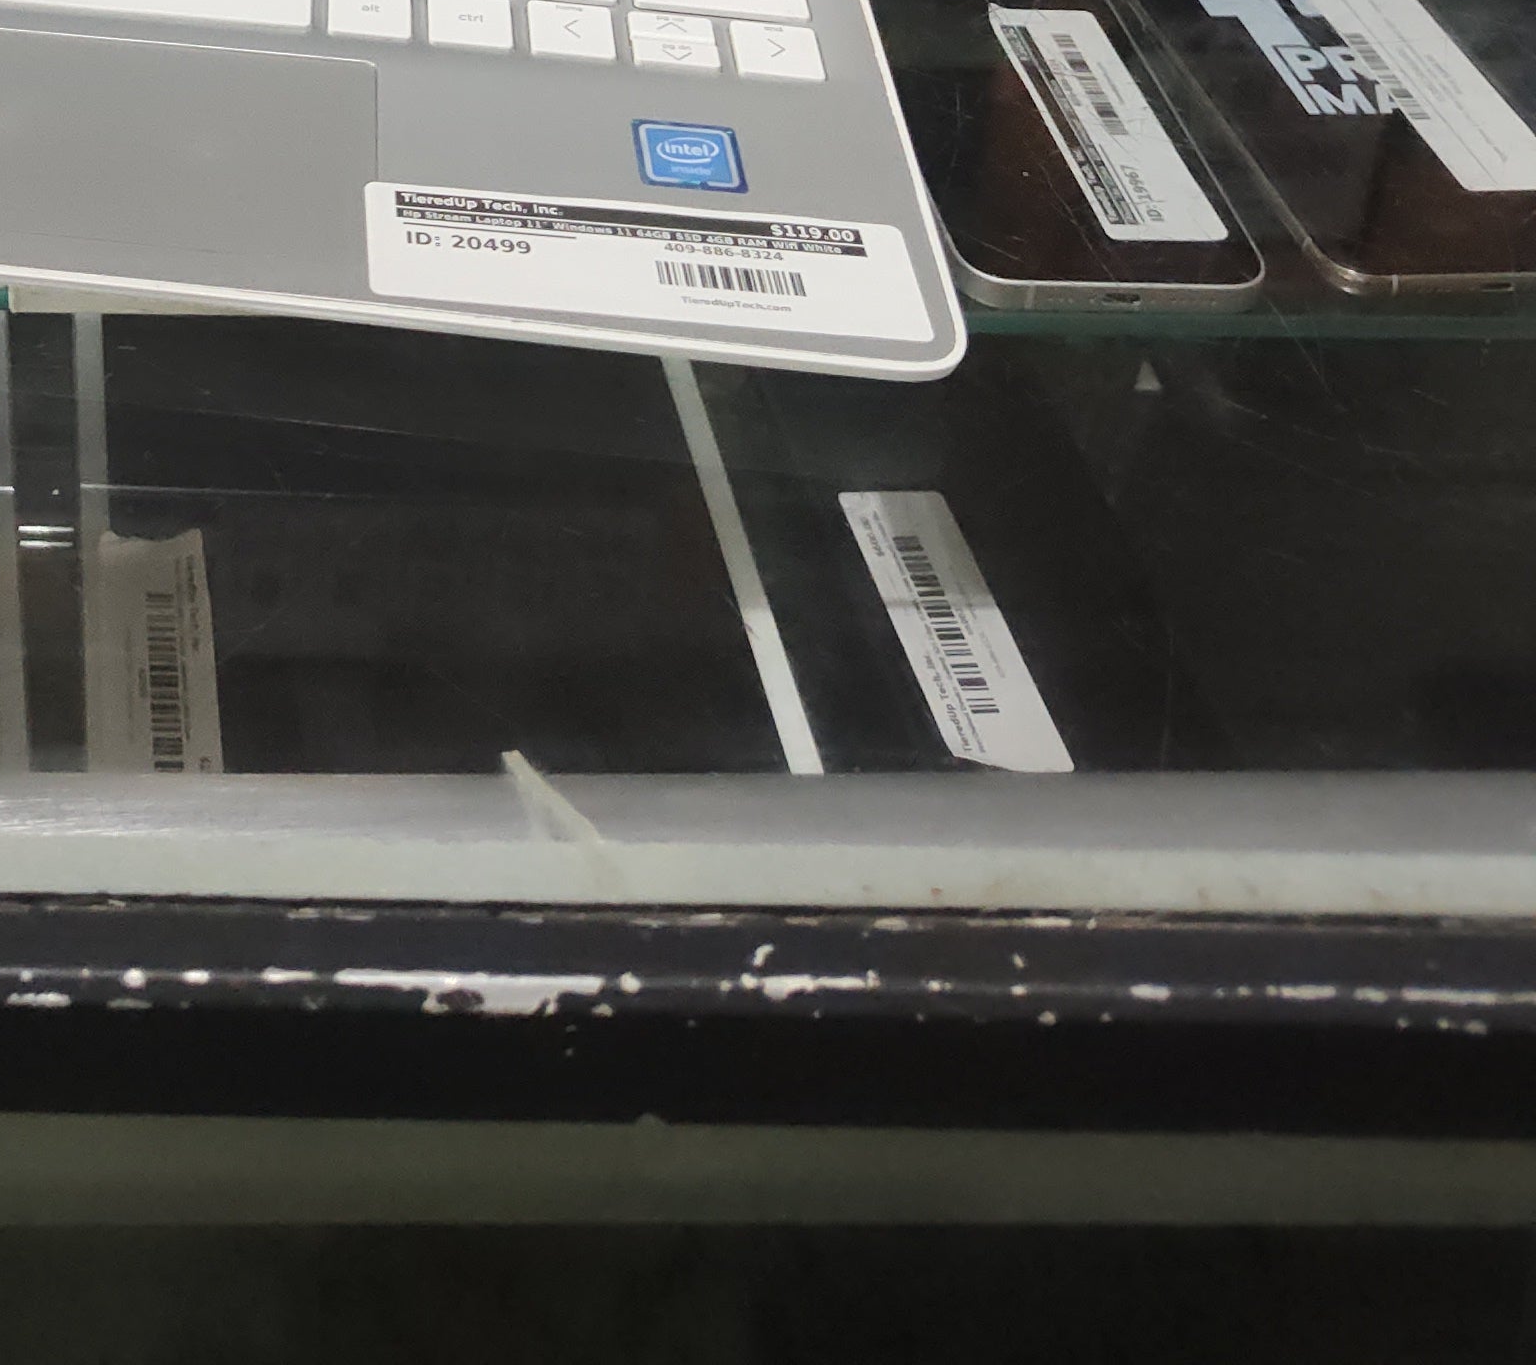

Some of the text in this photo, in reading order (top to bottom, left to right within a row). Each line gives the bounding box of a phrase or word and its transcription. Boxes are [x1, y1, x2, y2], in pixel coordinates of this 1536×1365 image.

[1278, 45, 1378, 82] PR
[663, 138, 712, 160] intel
[400, 192, 855, 243] TieredUp Tech, Inc. $119.00
[406, 230, 531, 254] ID: 20499
[425, 211, 472, 223] Stream
[476, 216, 522, 228] Laptop
[552, 222, 614, 235] Windows
[616, 227, 633, 237] 11
[737, 238, 767, 248] RAM
[802, 243, 843, 254] White
[663, 242, 784, 261] 409-886-8324
[681, 295, 792, 312] TieredUpTech.com
